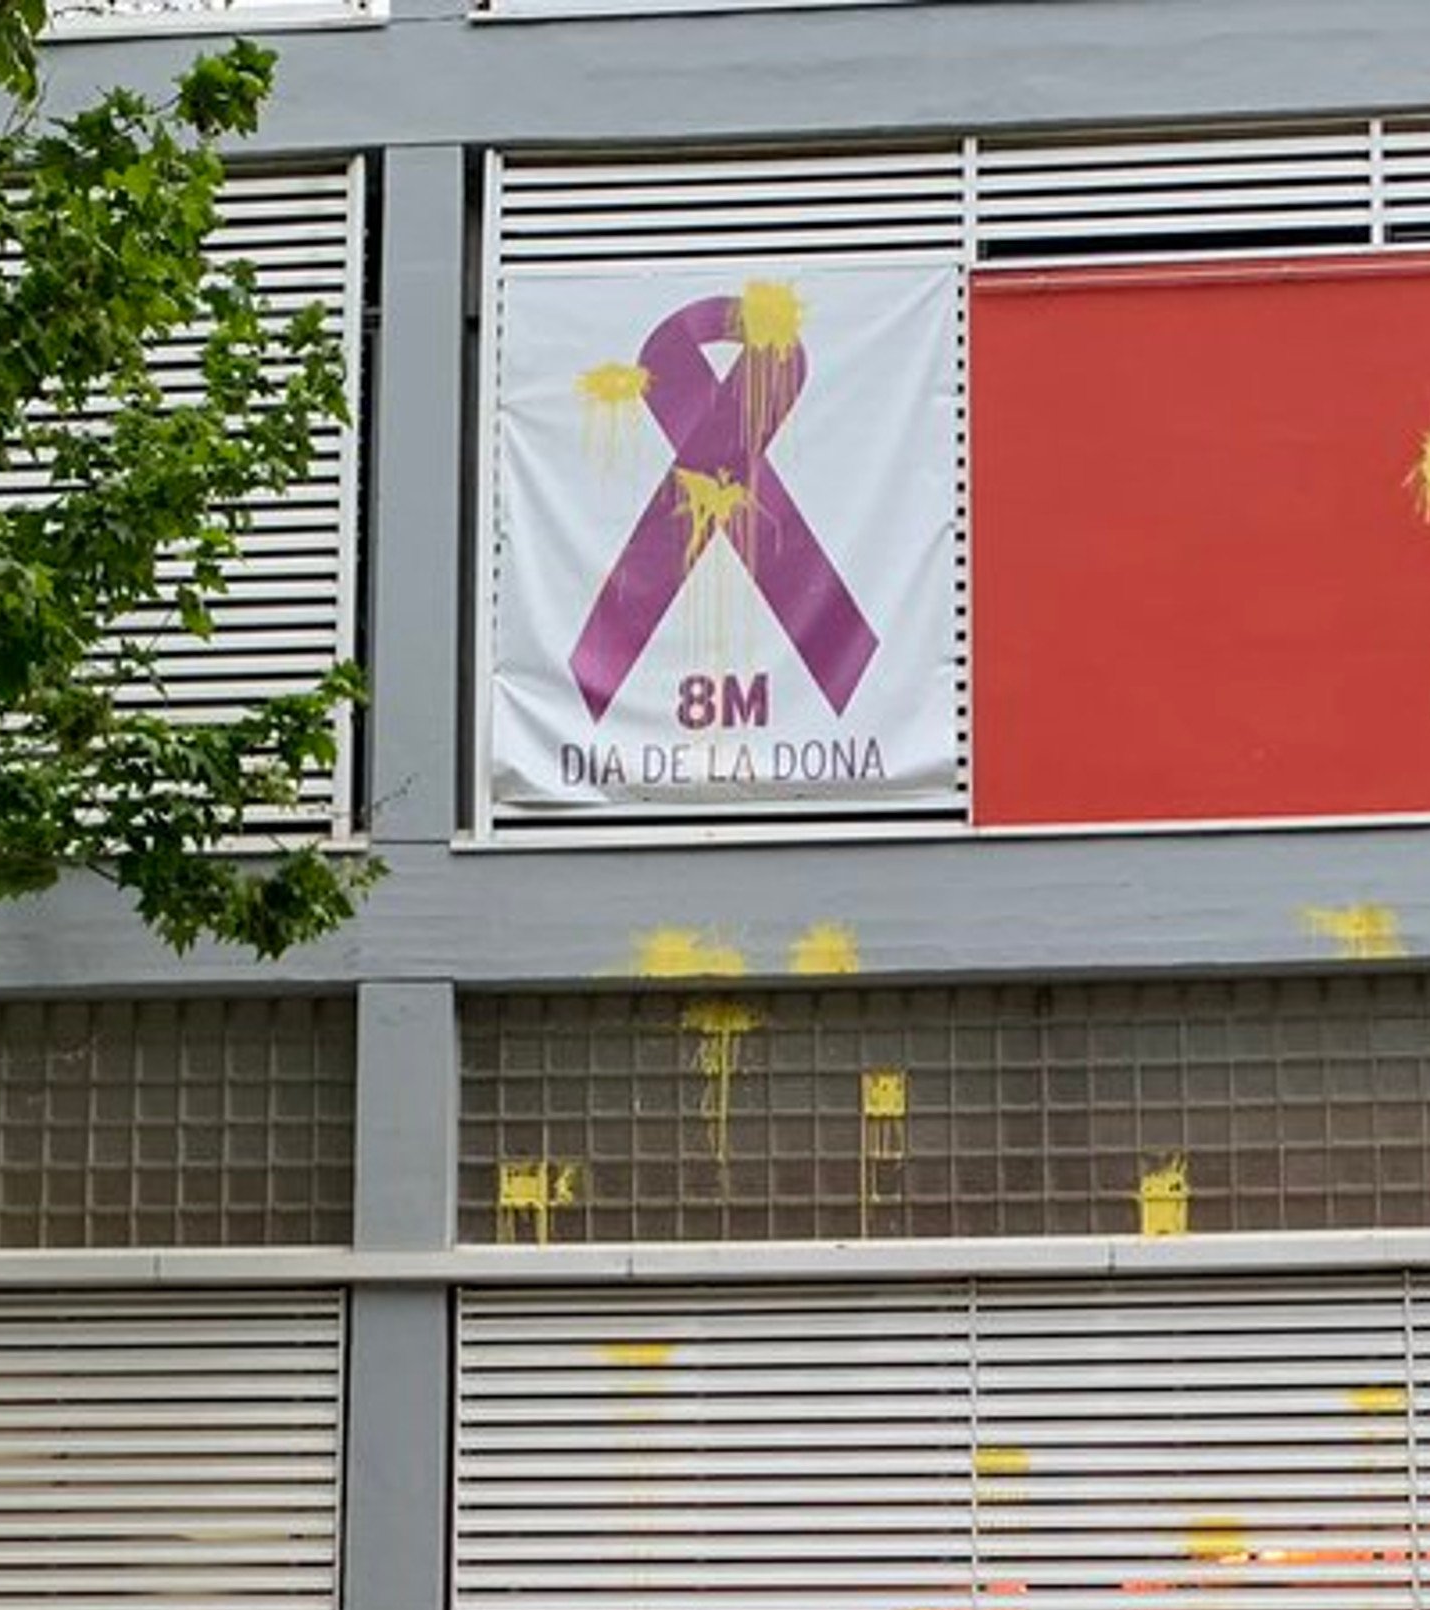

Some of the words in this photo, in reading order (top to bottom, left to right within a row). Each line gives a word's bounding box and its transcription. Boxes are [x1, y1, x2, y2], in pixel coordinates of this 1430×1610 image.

[677, 672, 769, 730] 8M
[642, 744, 691, 784] DE
[707, 746, 755, 783] LA
[773, 737, 886, 783] DONA
